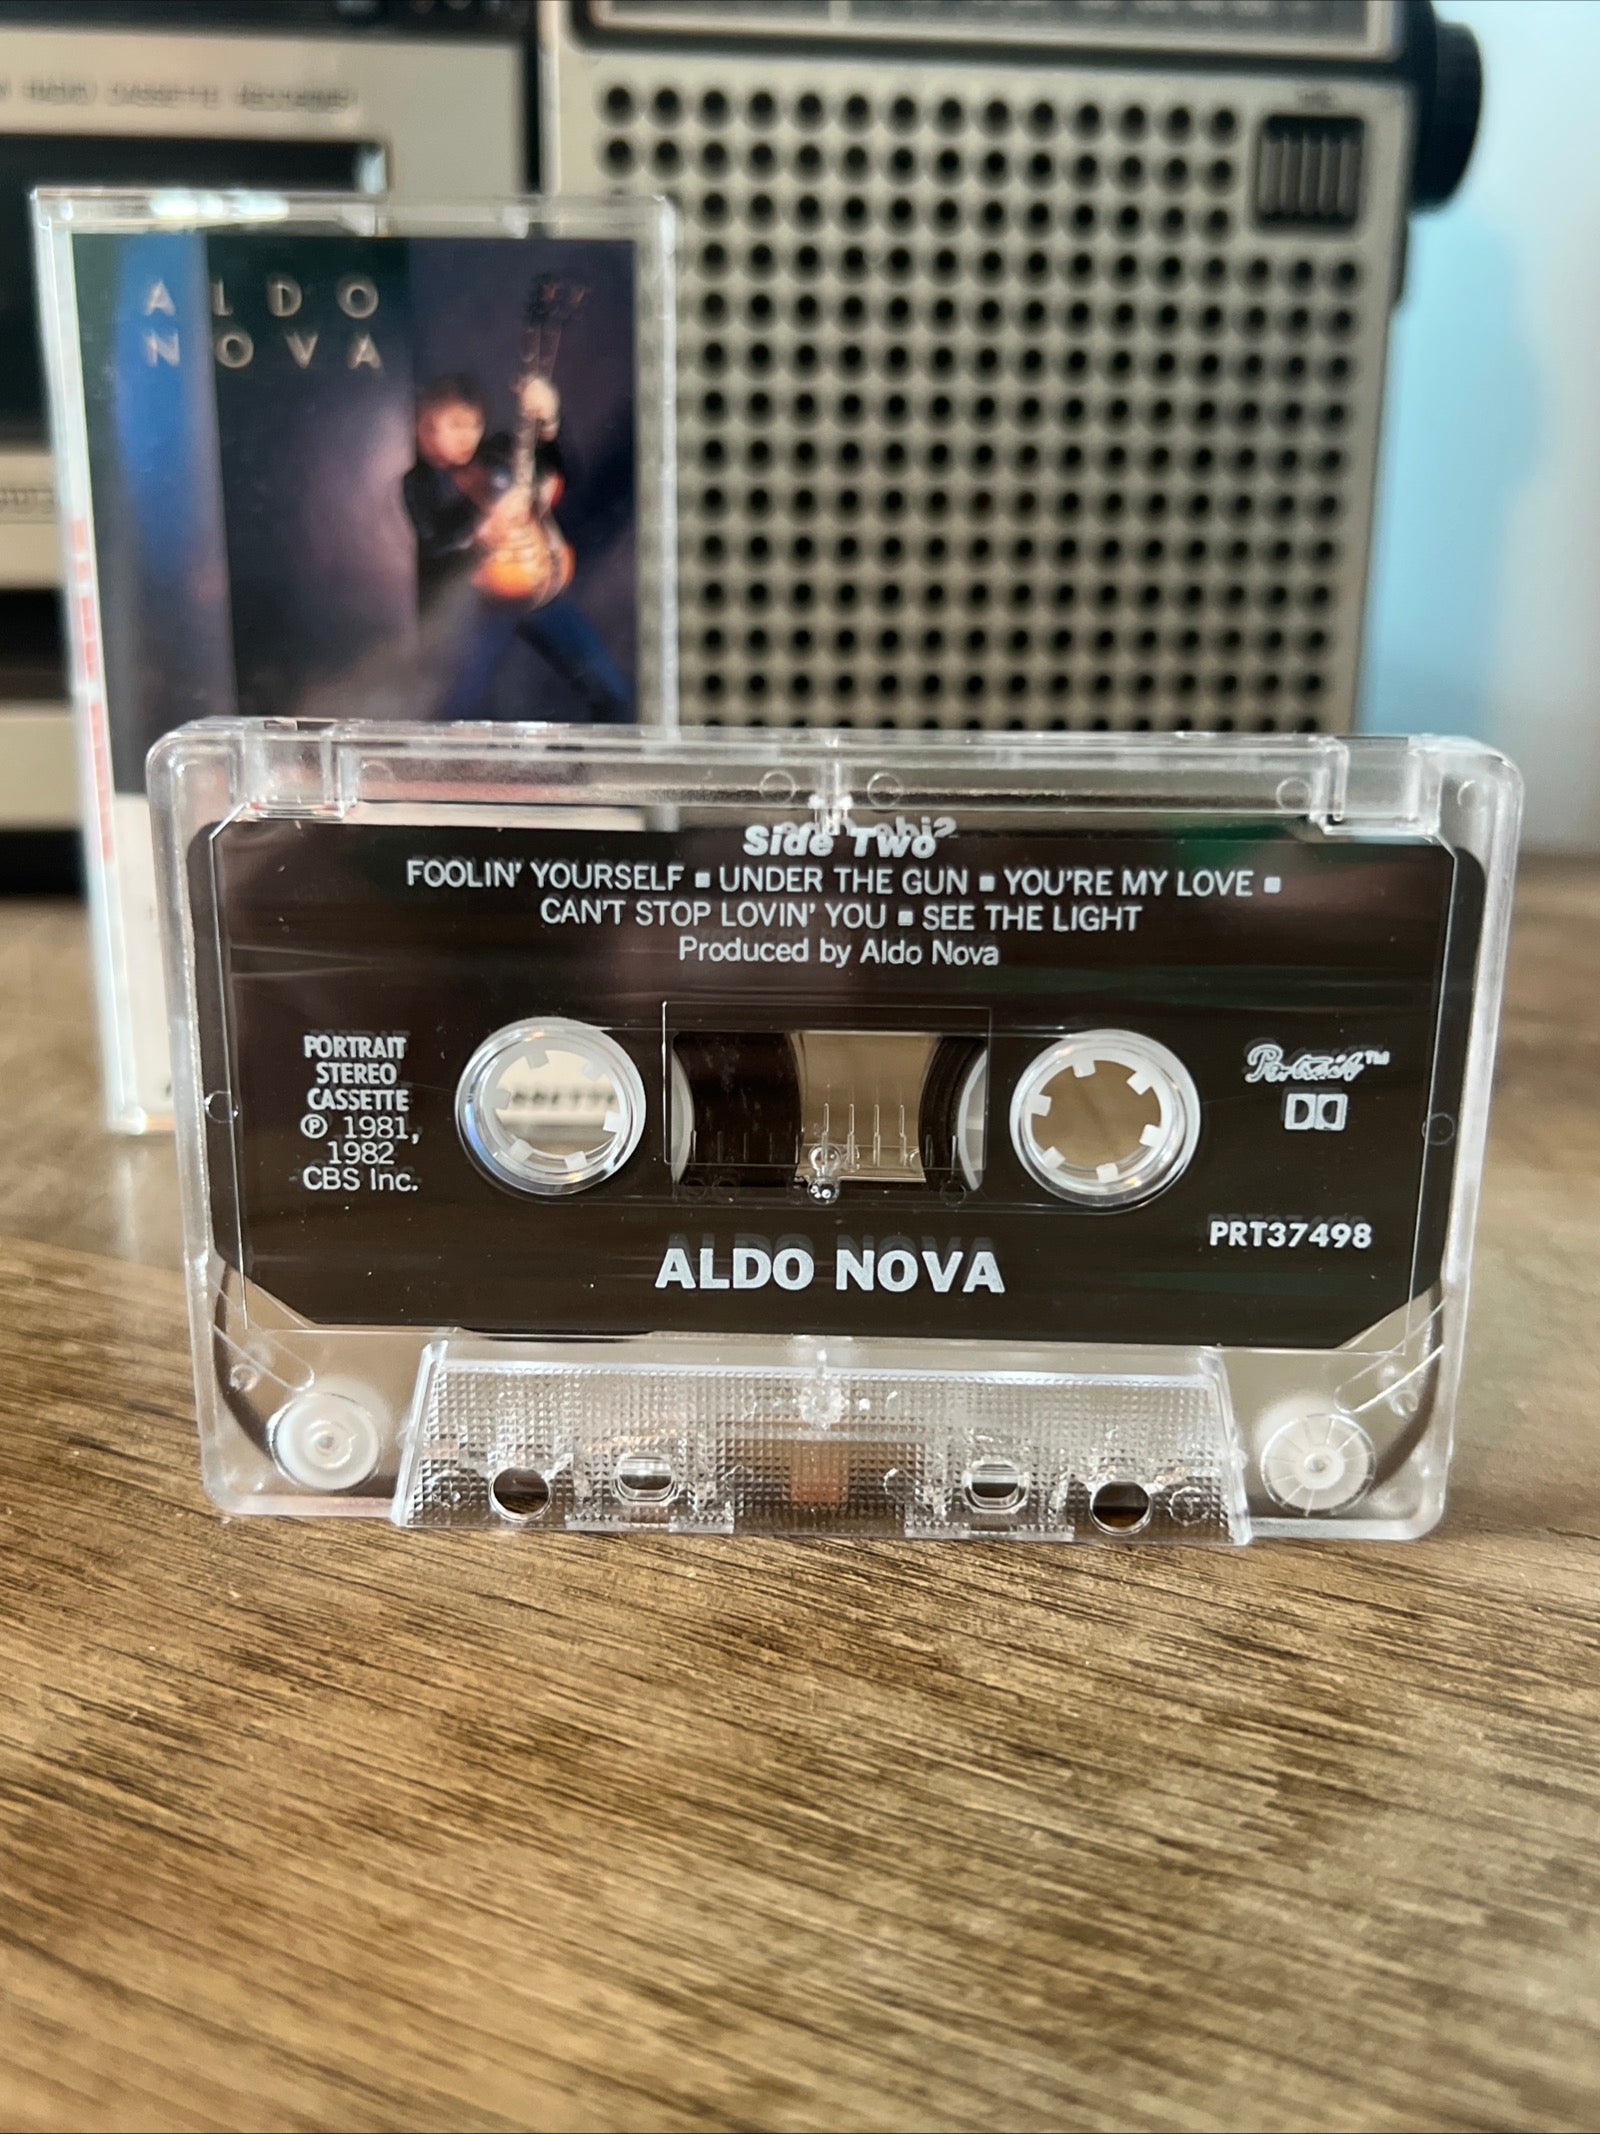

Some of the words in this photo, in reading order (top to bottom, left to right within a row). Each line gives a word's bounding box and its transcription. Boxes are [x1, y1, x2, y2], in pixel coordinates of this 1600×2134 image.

[145, 276, 379, 319] ALDO
[144, 331, 384, 369] NOVA
[742, 824, 834, 857] Side
[850, 827, 936, 860] Two
[407, 859, 522, 888] FOOLIN'
[530, 861, 685, 891] YOURSELF
[719, 865, 823, 893] UNDER
[833, 867, 893, 895] THE
[901, 868, 968, 895] GUN
[1003, 868, 1114, 896] YOU'RE
[1122, 869, 1169, 896] MY
[1177, 869, 1255, 897] LOVE
[540, 897, 627, 925] CAN'T
[635, 899, 712, 927] STOP
[721, 900, 817, 928] LOVIN'
[823, 901, 887, 929] YOU
[922, 904, 975, 931] SEE
[984, 904, 1044, 931] THE
[1053, 905, 1143, 932] LIGHT
[678, 934, 810, 963] Produced
[819, 936, 852, 969] by
[859, 938, 923, 965] Aldo
[931, 939, 999, 966] Nova
[303, 1034, 407, 1060] PORTRAIT
[315, 1061, 397, 1085] STEREO
[306, 1087, 410, 1112] CASSETTE
[343, 1115, 419, 1146] 1981,
[327, 1140, 395, 1165] 1982
[302, 1165, 361, 1191] CBS
[370, 1167, 419, 1192] Inc.
[1209, 1220, 1372, 1249] PRT37498
[654, 1247, 815, 1291] ALDO
[835, 1248, 1006, 1294] NOVA
